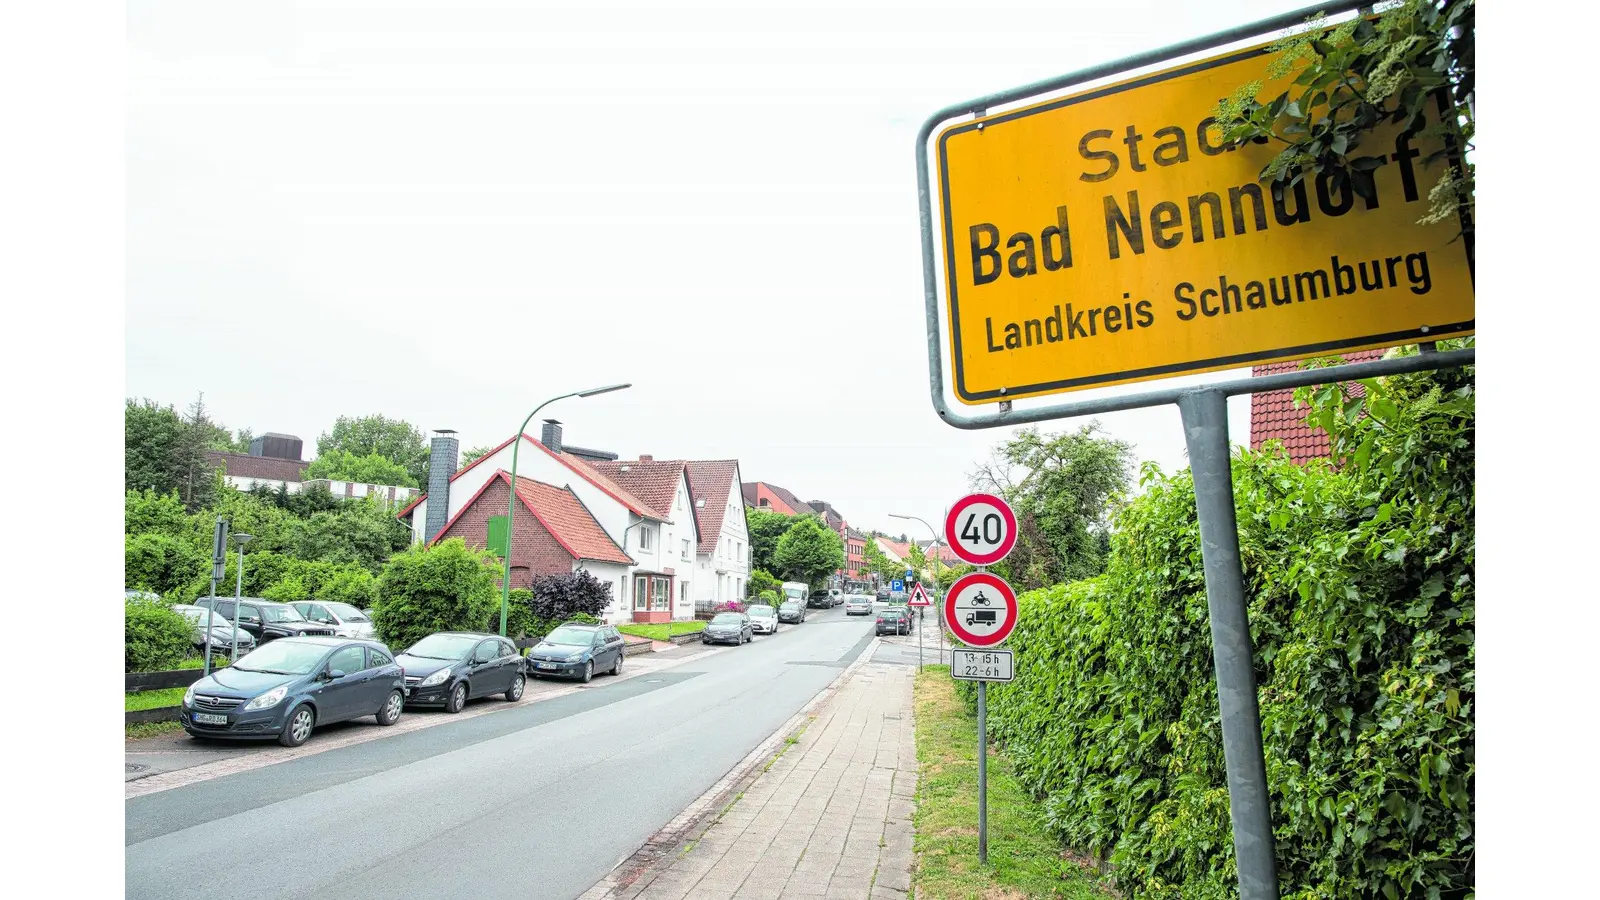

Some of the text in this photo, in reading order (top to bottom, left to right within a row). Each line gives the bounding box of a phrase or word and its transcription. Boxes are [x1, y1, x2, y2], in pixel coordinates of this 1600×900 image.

[969, 129, 1420, 286] Bad Nenndorf
[985, 251, 1432, 353] Landkreis Schaumburg
[961, 513, 1001, 545] 40
[894, 581, 901, 590] P
[993, 654, 999, 664] h
[993, 666, 999, 676] h
